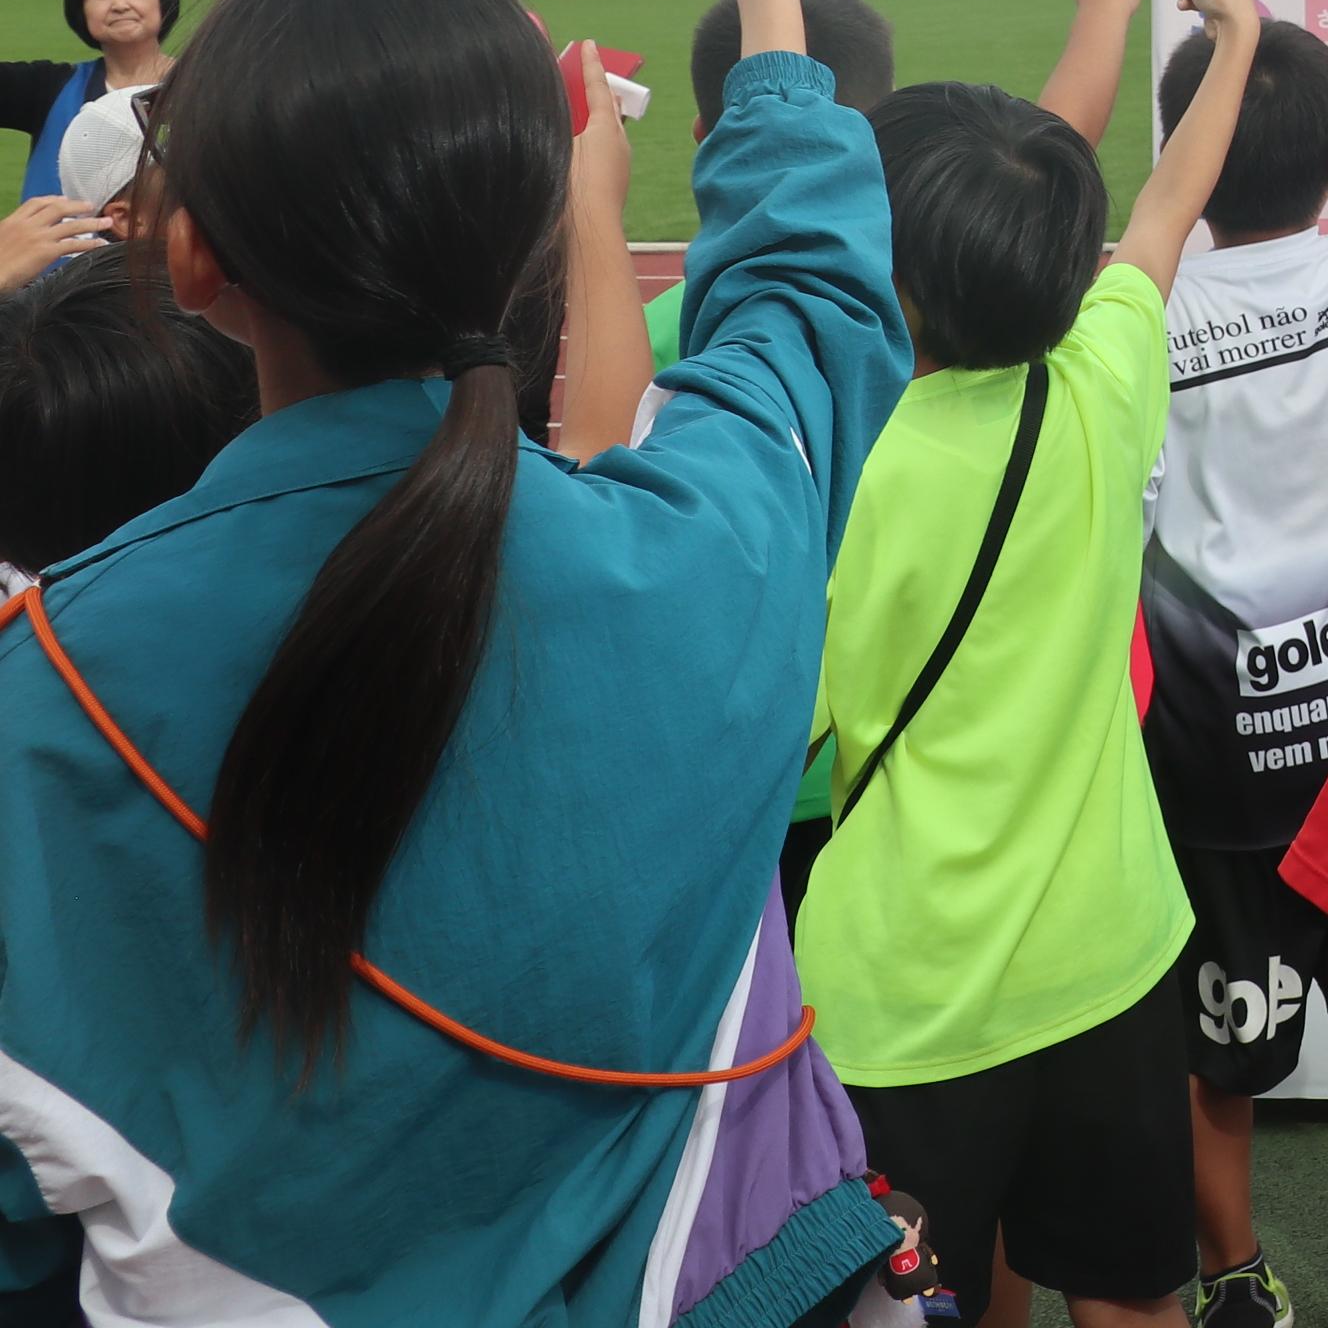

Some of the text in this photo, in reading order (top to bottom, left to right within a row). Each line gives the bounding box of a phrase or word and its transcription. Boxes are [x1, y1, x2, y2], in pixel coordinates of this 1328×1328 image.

[1259, 305, 1308, 332] não
[1173, 328, 1307, 376] vai morrer
[1248, 739, 1313, 774] vem
